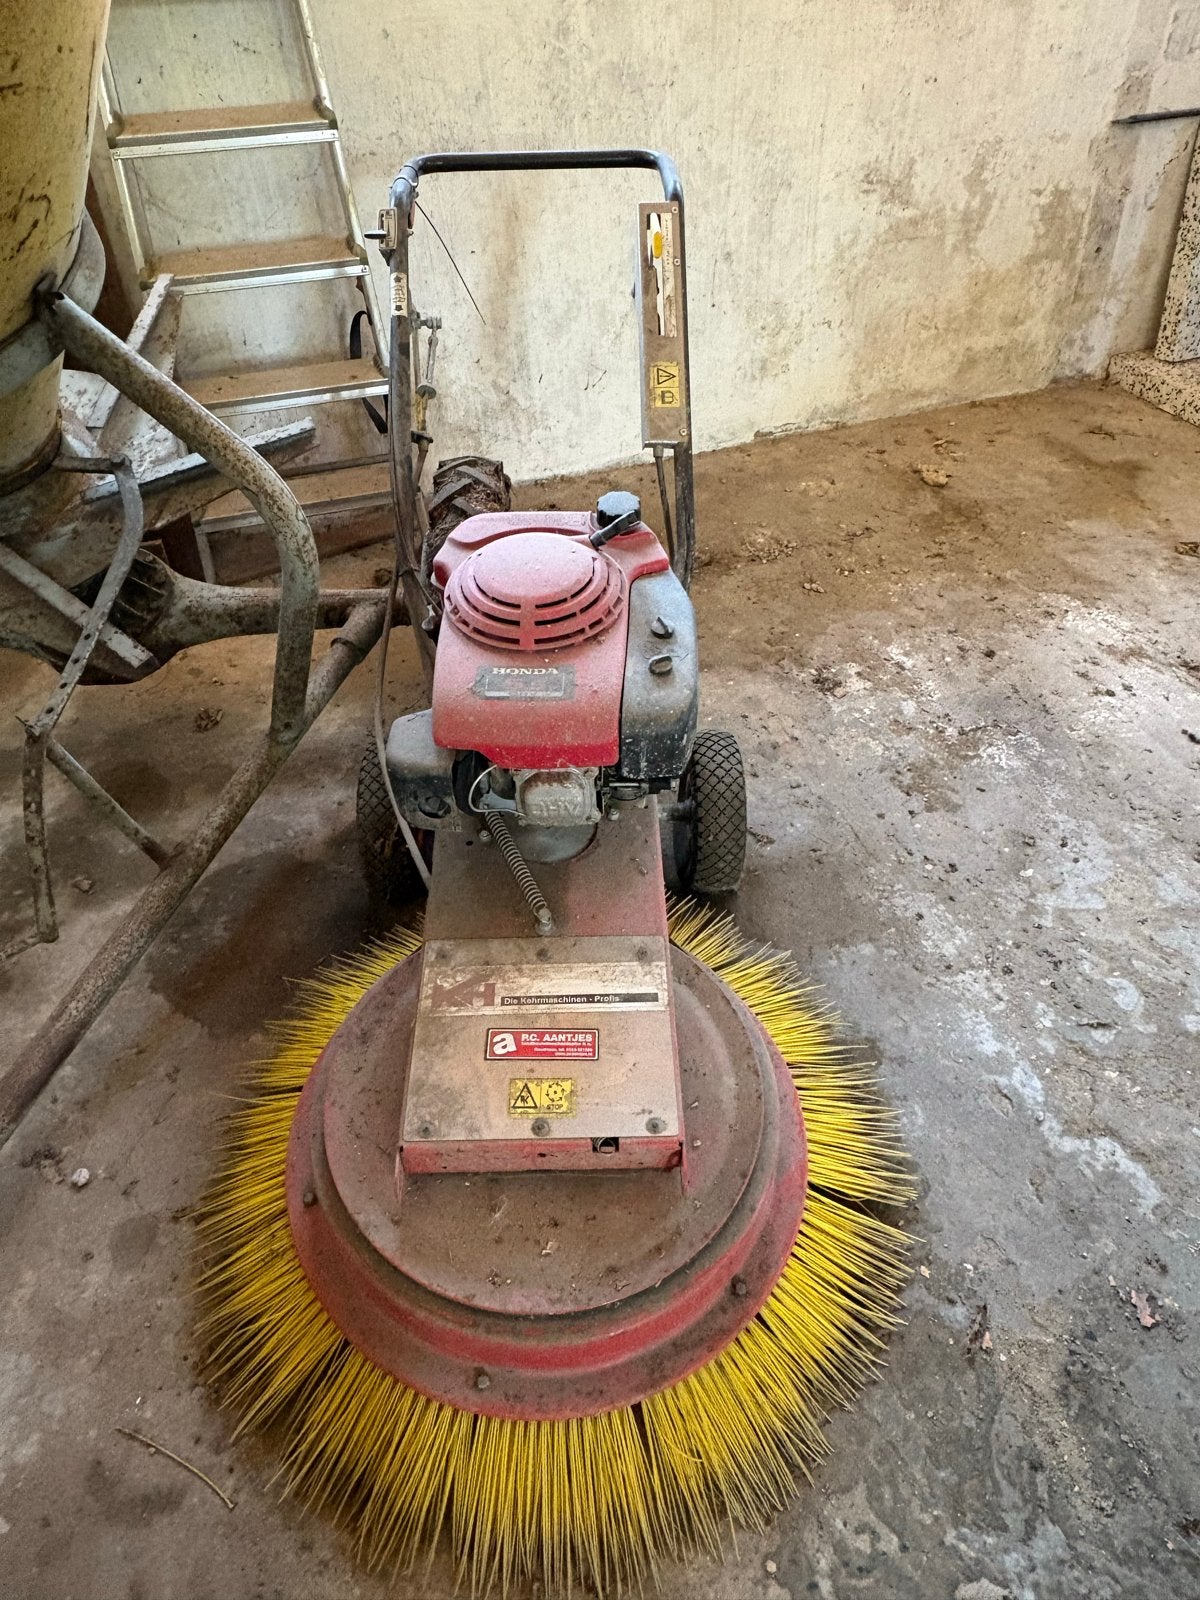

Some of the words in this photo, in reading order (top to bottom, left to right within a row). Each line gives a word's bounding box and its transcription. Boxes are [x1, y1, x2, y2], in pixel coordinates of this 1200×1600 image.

[492, 667, 560, 675] HONDA
[504, 997, 518, 1005] Die
[543, 1033, 593, 1042] AANTJES
